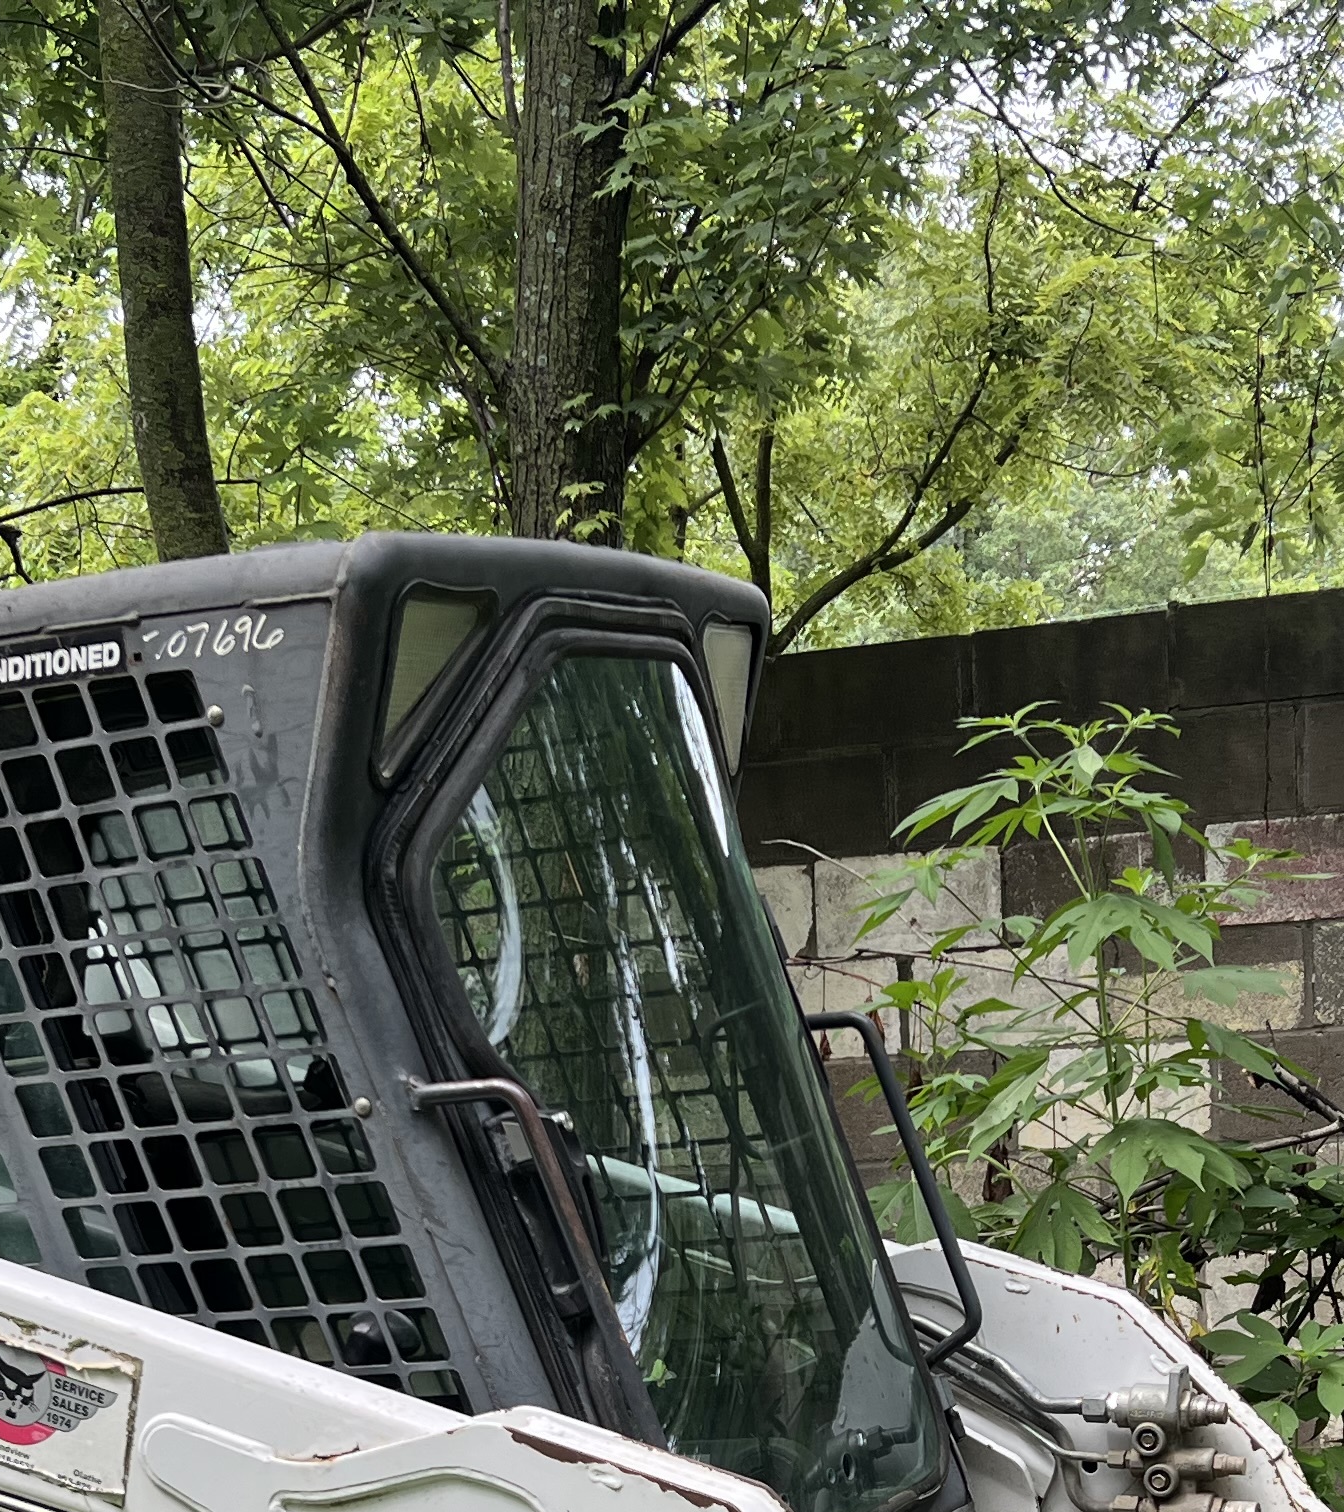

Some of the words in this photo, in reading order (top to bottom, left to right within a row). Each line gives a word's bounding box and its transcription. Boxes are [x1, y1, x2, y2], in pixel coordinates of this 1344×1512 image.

[54, 1378, 105, 1404] SERVICE
[52, 1395, 89, 1417] SALES
[46, 1412, 71, 1429] 1974
